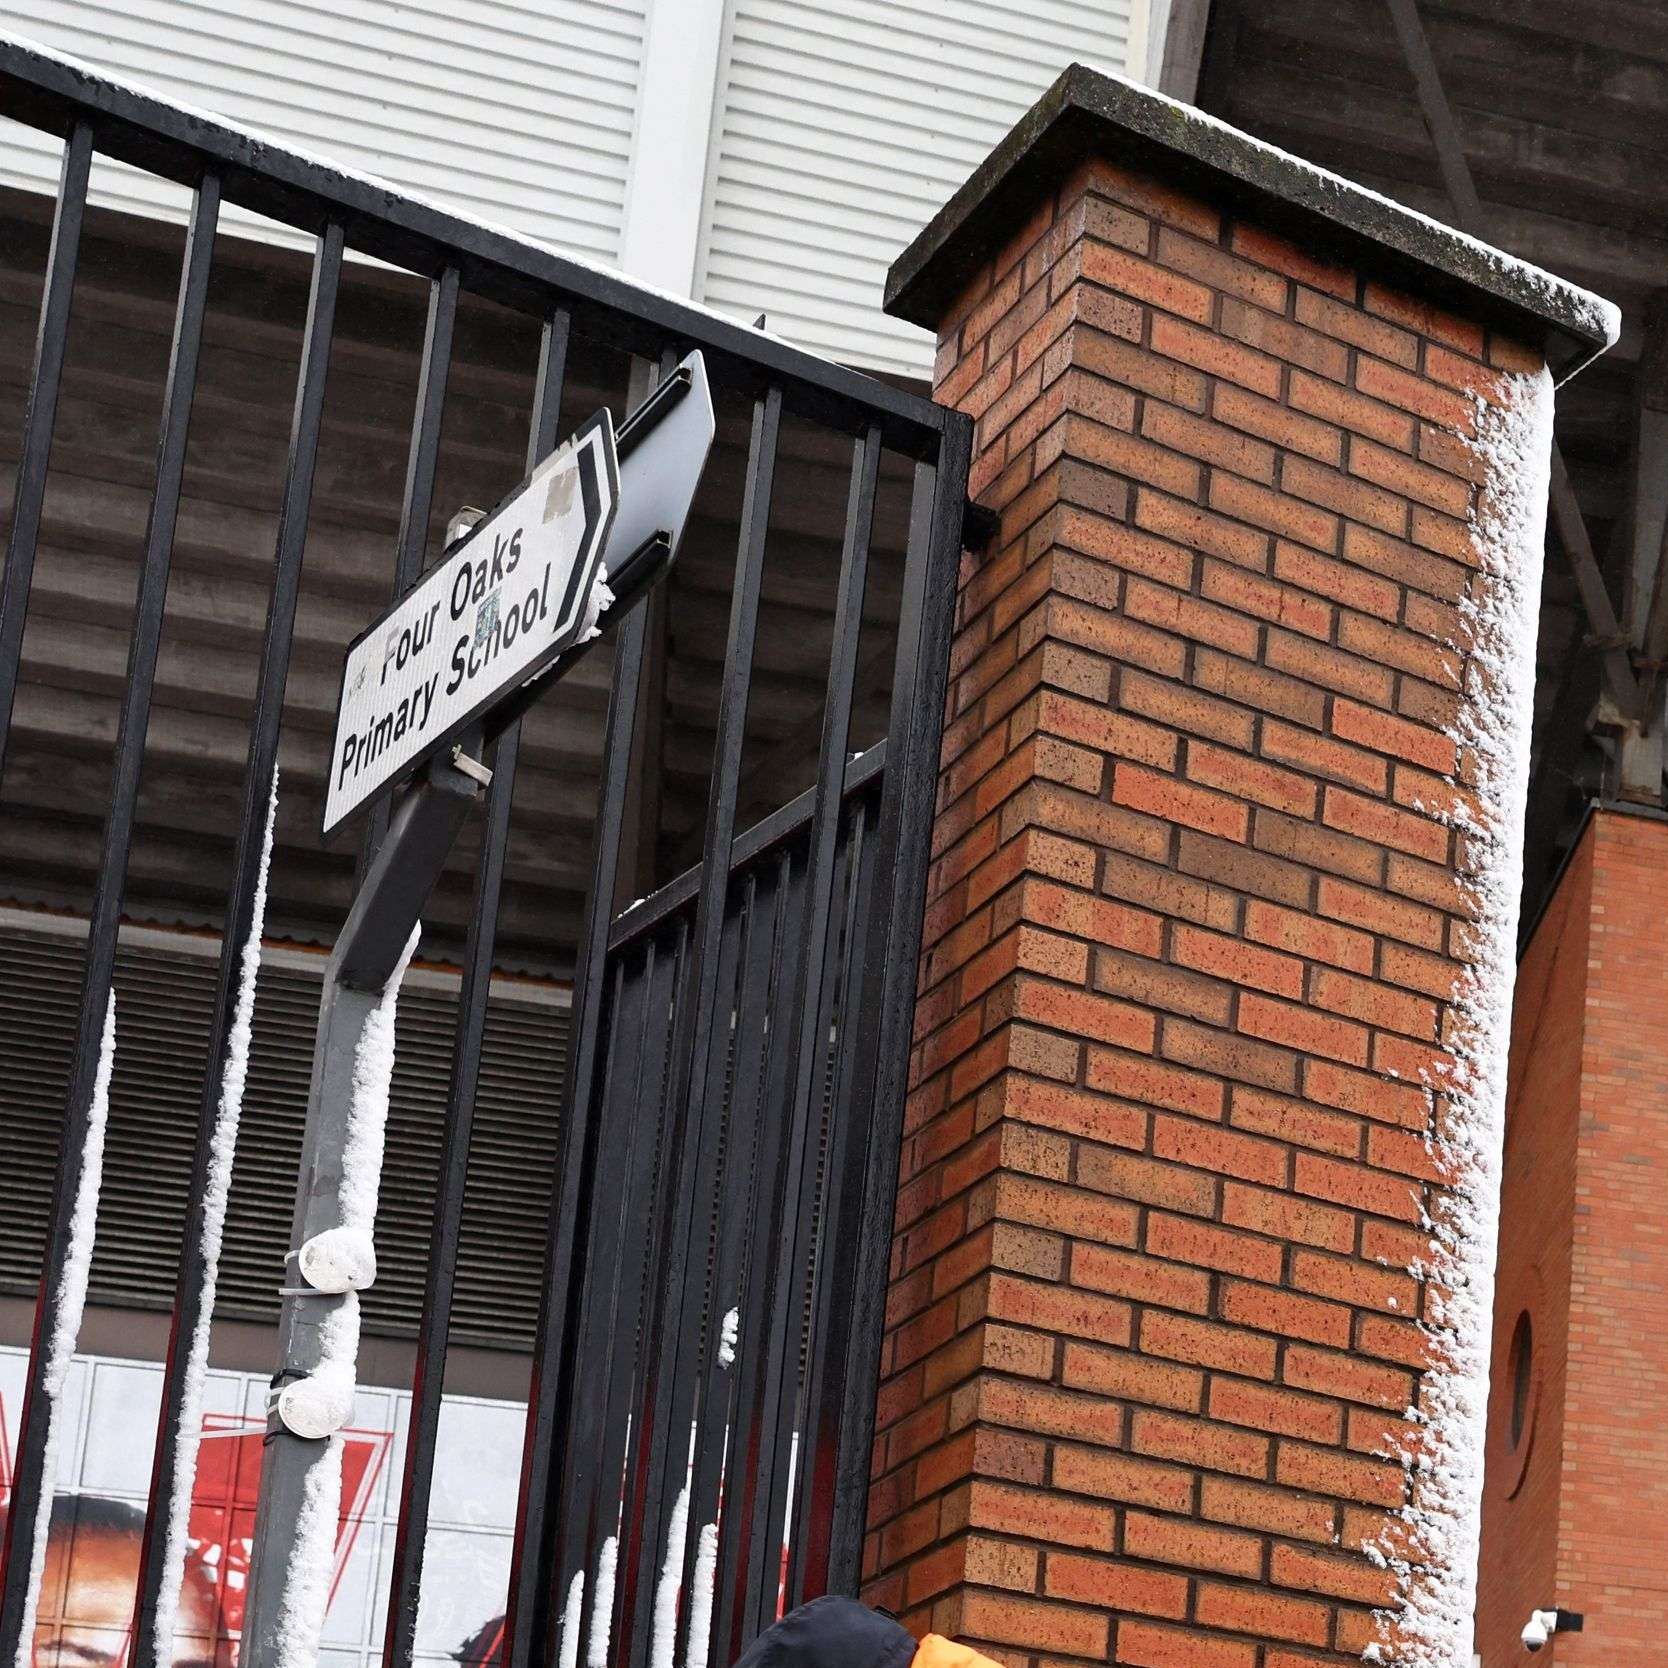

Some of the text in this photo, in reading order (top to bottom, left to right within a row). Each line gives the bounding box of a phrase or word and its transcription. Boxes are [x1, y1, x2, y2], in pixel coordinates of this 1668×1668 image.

[338, 561, 552, 791] Primary School
[380, 527, 523, 686] Four Oaks
